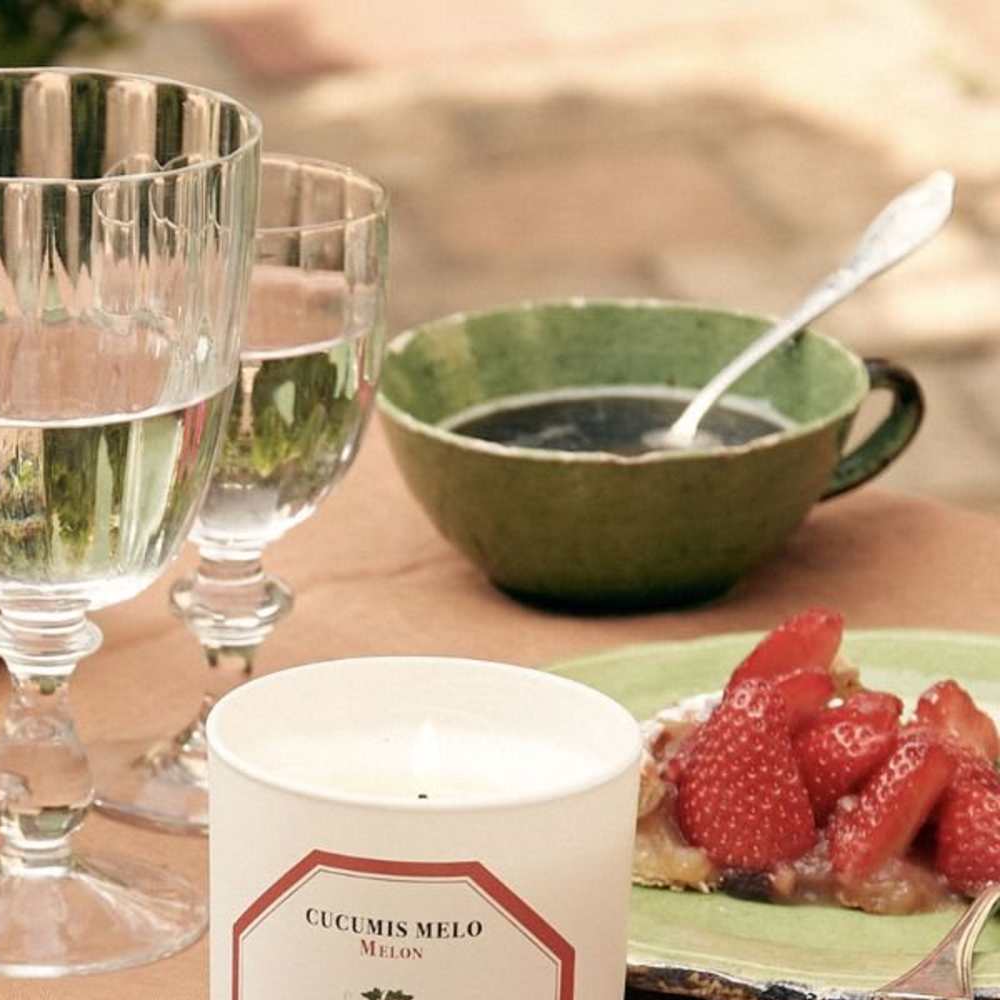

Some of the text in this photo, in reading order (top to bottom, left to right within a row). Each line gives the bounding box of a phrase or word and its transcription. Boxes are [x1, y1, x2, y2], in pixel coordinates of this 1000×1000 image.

[305, 907, 483, 939] CUCUMIS MELO
[360, 938, 424, 960] MELON
